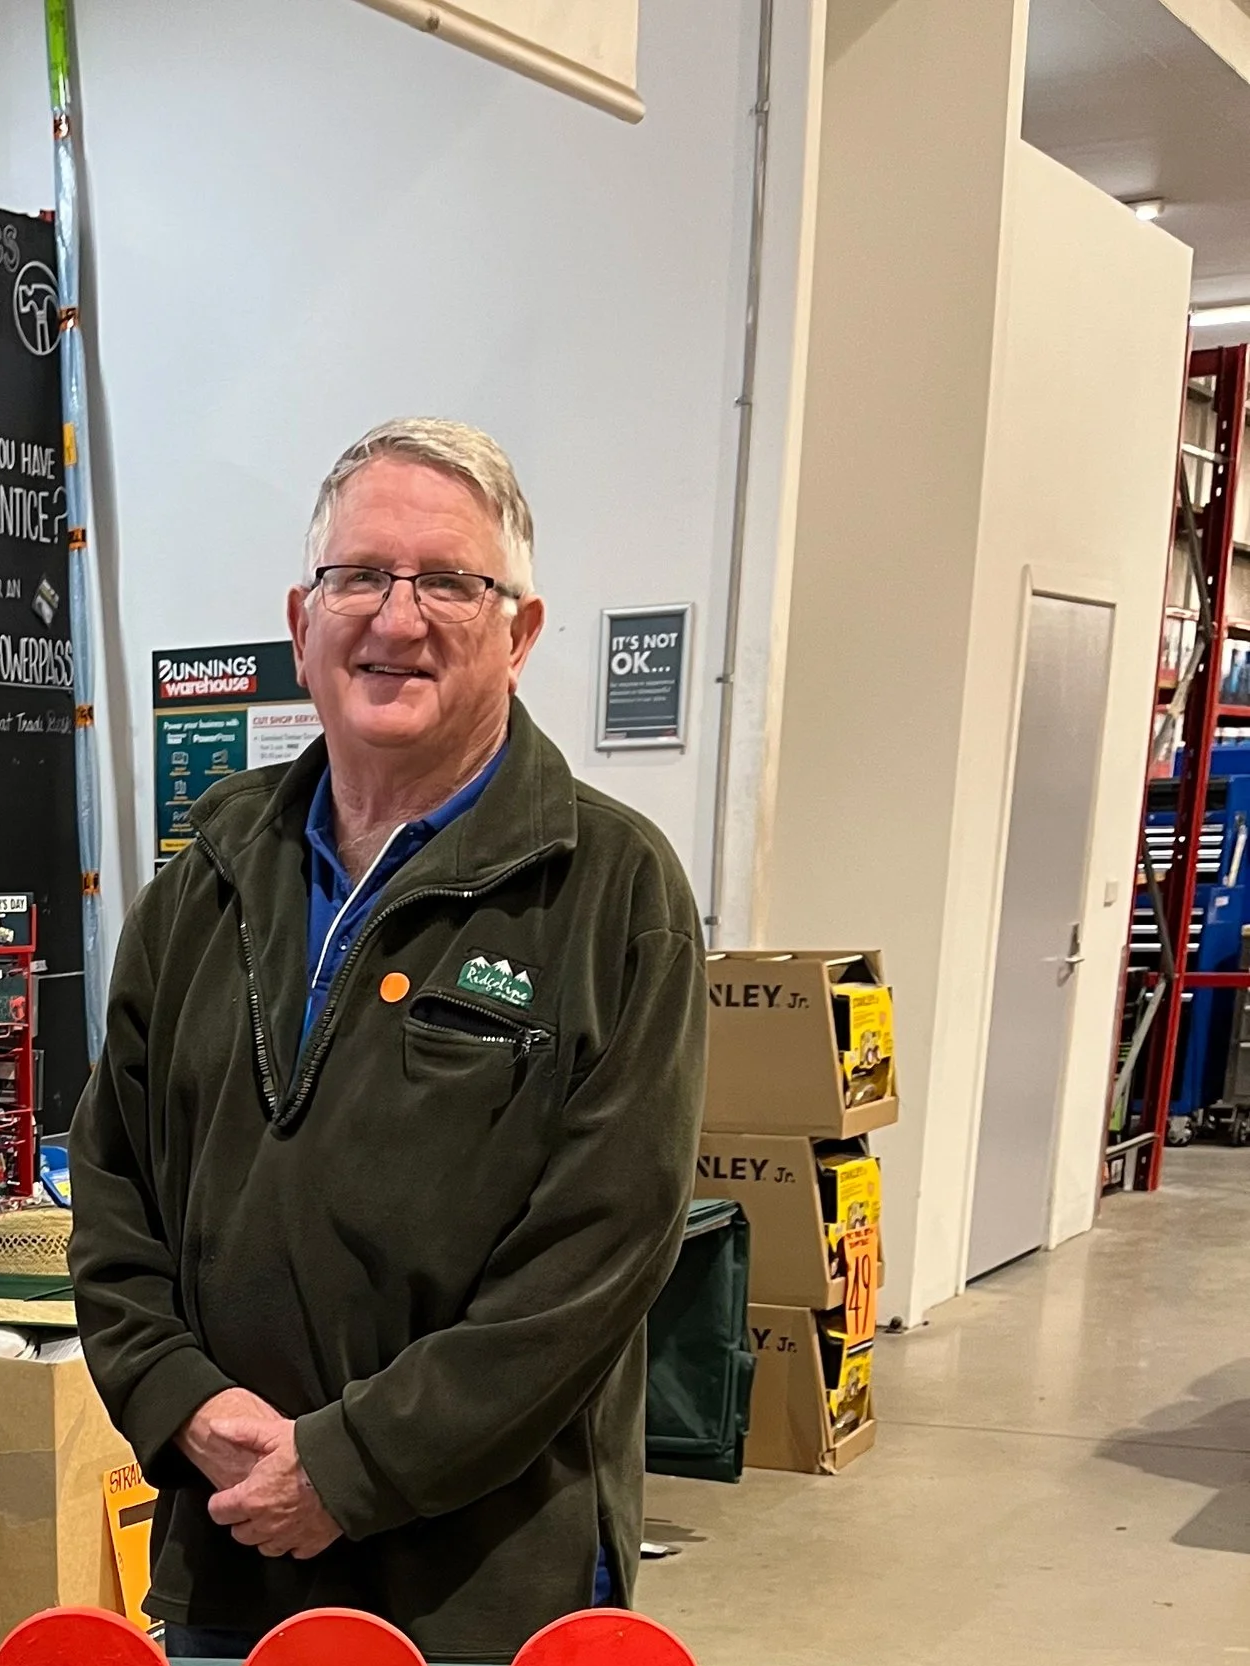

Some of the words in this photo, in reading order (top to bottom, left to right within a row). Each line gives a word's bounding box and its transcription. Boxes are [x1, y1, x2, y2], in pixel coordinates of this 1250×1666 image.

[21, 443, 55, 479] HAVE
[5, 578, 21, 599] AN
[611, 635, 640, 651] IT'S
[643, 632, 679, 649] NOT
[158, 656, 257, 682] BUNNINGS
[611, 651, 671, 676] OK...
[165, 677, 250, 697] warehouse
[10, 898, 25, 910] DAY
[465, 966, 529, 1001] Ridgeline
[787, 993, 810, 1009] Jr.
